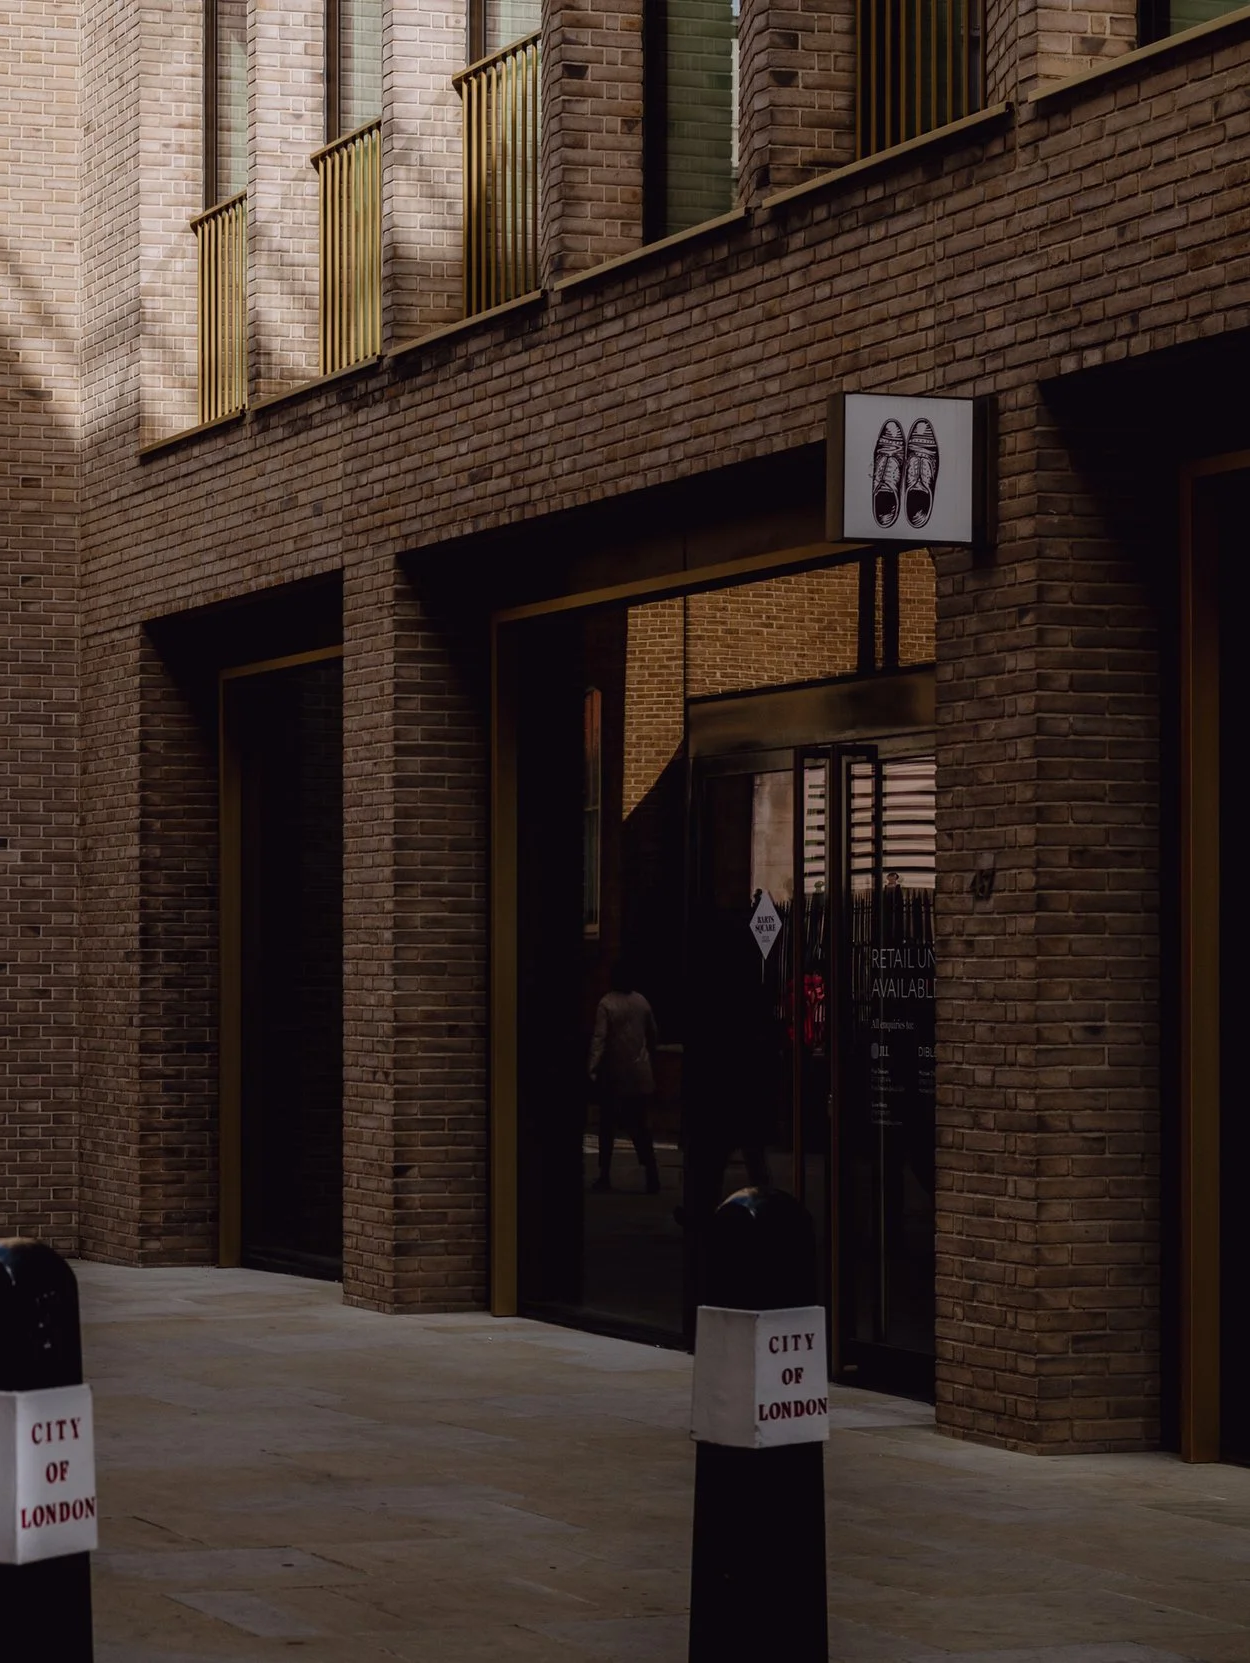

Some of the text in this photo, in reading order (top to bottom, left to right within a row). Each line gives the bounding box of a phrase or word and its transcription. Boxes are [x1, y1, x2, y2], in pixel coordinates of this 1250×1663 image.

[755, 923, 776, 934] SQUARE
[757, 915, 775, 923] BARTS
[871, 948, 915, 969] RETAIL
[918, 1046, 936, 1058] DIBL
[768, 1333, 815, 1354] CITY
[781, 1367, 804, 1385] OF
[758, 1398, 828, 1421] LONDON
[31, 1417, 81, 1444] CITY
[45, 1460, 69, 1483] OF
[21, 1497, 96, 1529] LONDON
